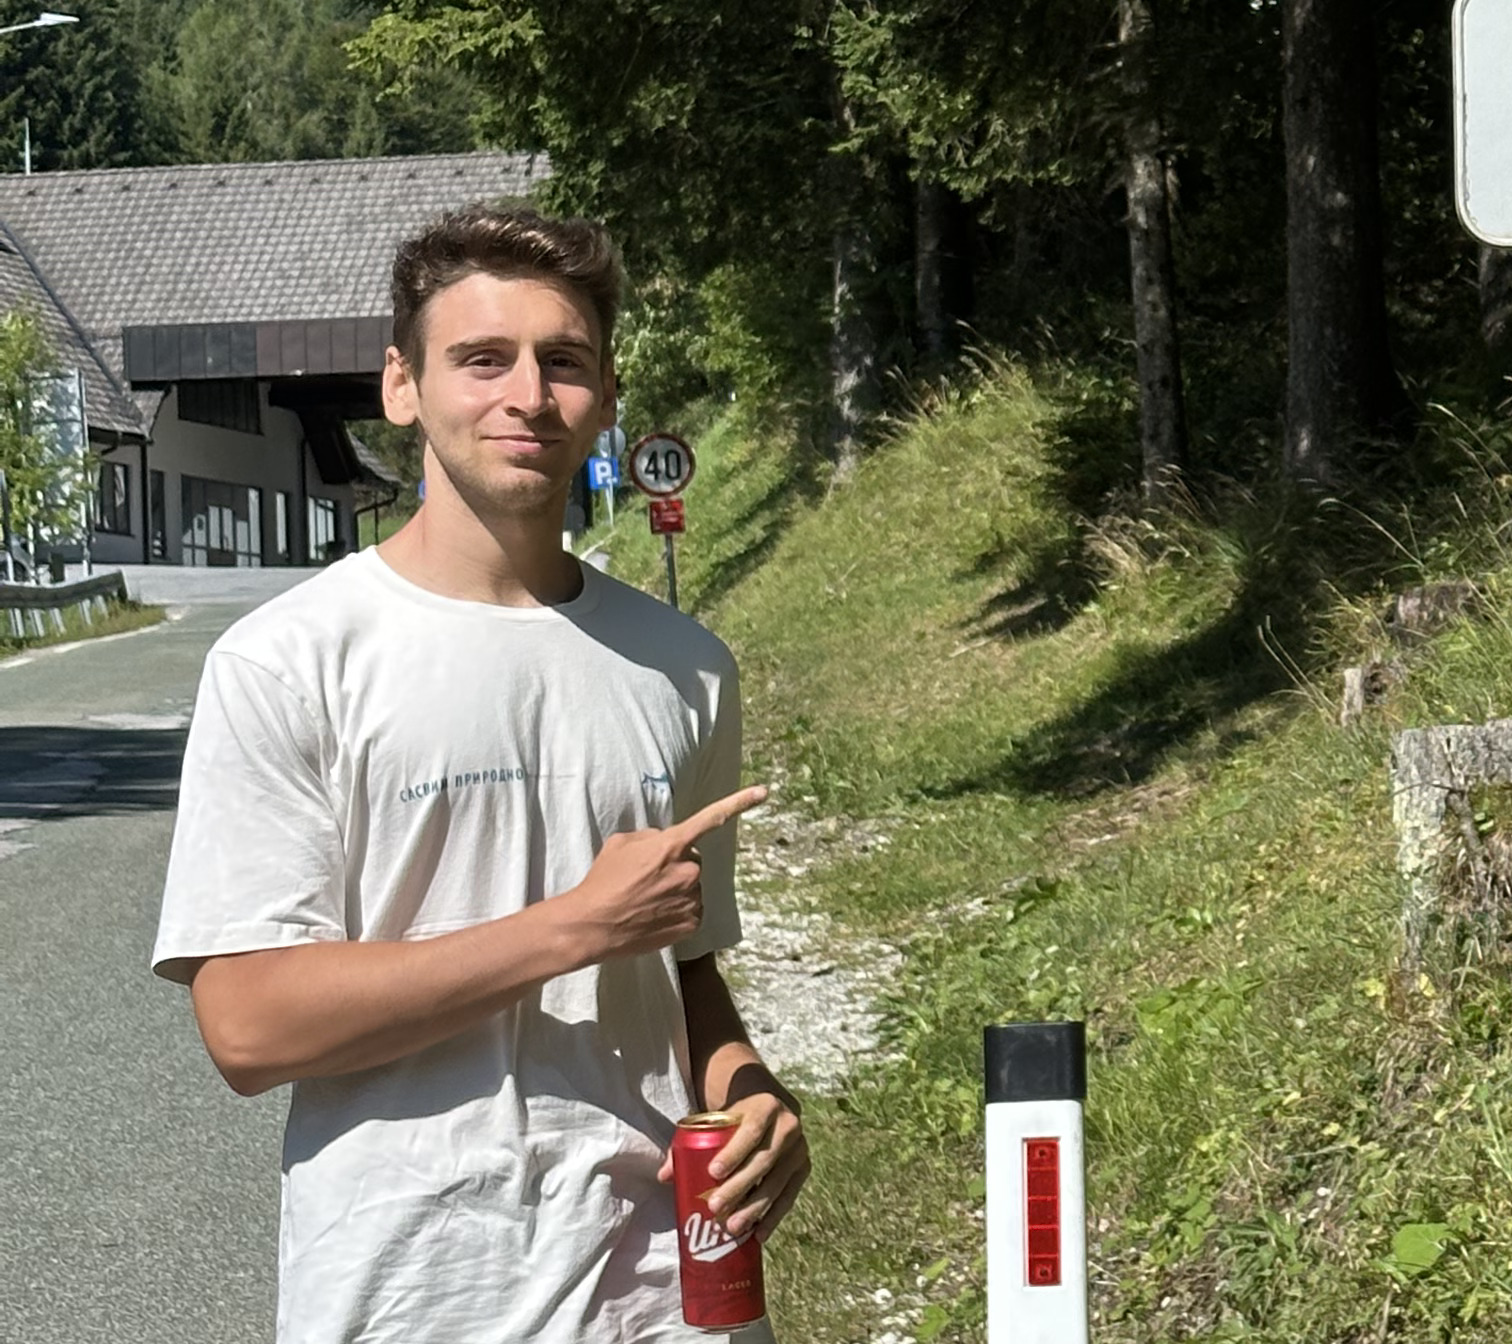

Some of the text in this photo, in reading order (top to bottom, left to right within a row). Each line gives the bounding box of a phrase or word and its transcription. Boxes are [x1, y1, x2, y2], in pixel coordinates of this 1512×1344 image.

[594, 460, 613, 486] P
[644, 449, 682, 481] 40
[455, 767, 525, 788] ПРИРОДНО
